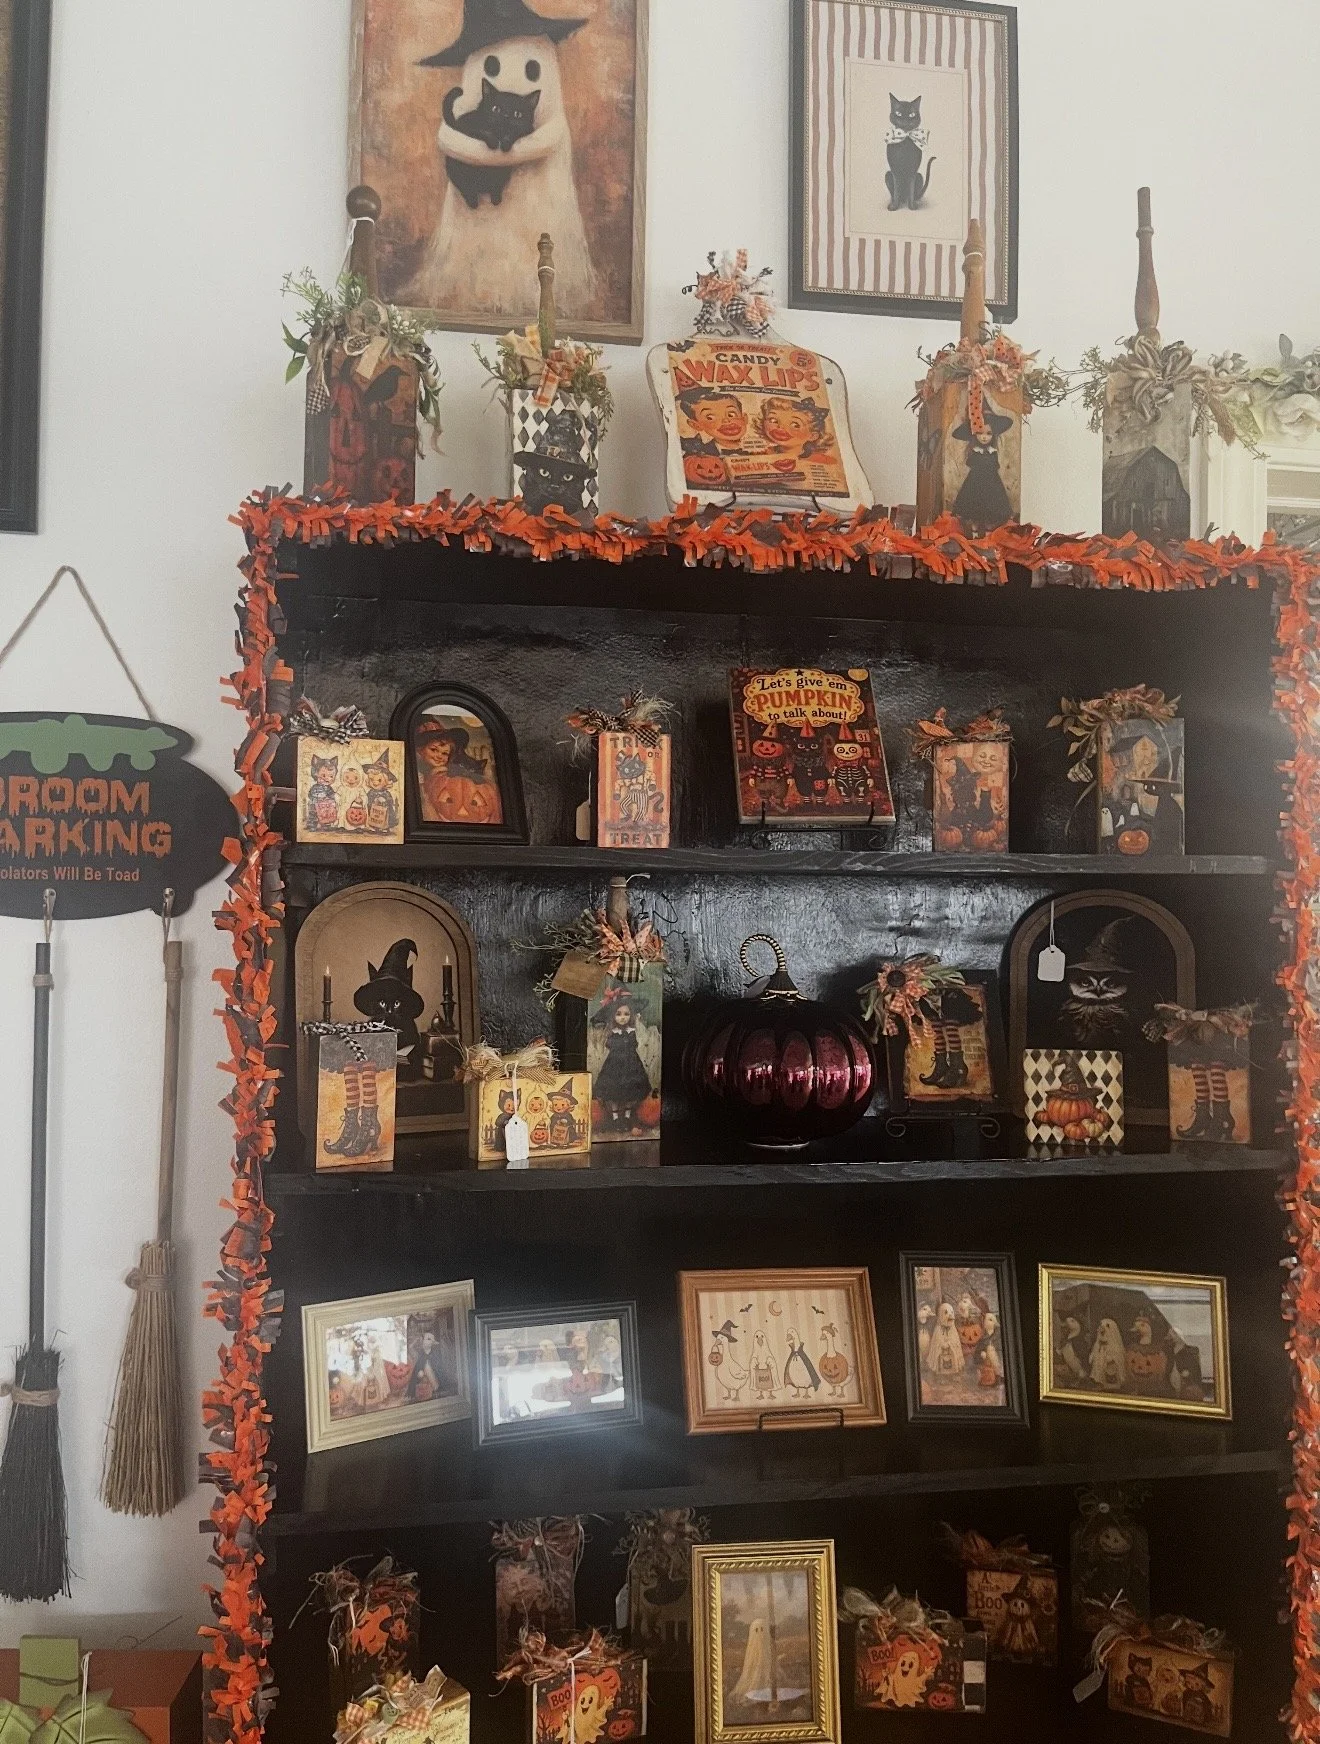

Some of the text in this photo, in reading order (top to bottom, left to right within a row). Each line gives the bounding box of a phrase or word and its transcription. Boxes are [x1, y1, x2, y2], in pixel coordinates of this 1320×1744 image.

[715, 352, 781, 366] CANDY
[682, 358, 820, 391] WAX LIPS
[756, 676, 847, 691] Let's give 'em
[753, 689, 853, 712] PUMPKIN
[768, 708, 847, 721] to talk about!
[609, 735, 663, 751] TRIK
[857, 733, 868, 742] 31
[647, 751, 660, 759] OR
[0, 775, 151, 816] ROOM
[609, 832, 663, 846] TREAT
[53, 867, 80, 881] Will
[84, 867, 102, 881] Be
[106, 867, 140, 882] Toad
[973, 1590, 1003, 1610] Boo
